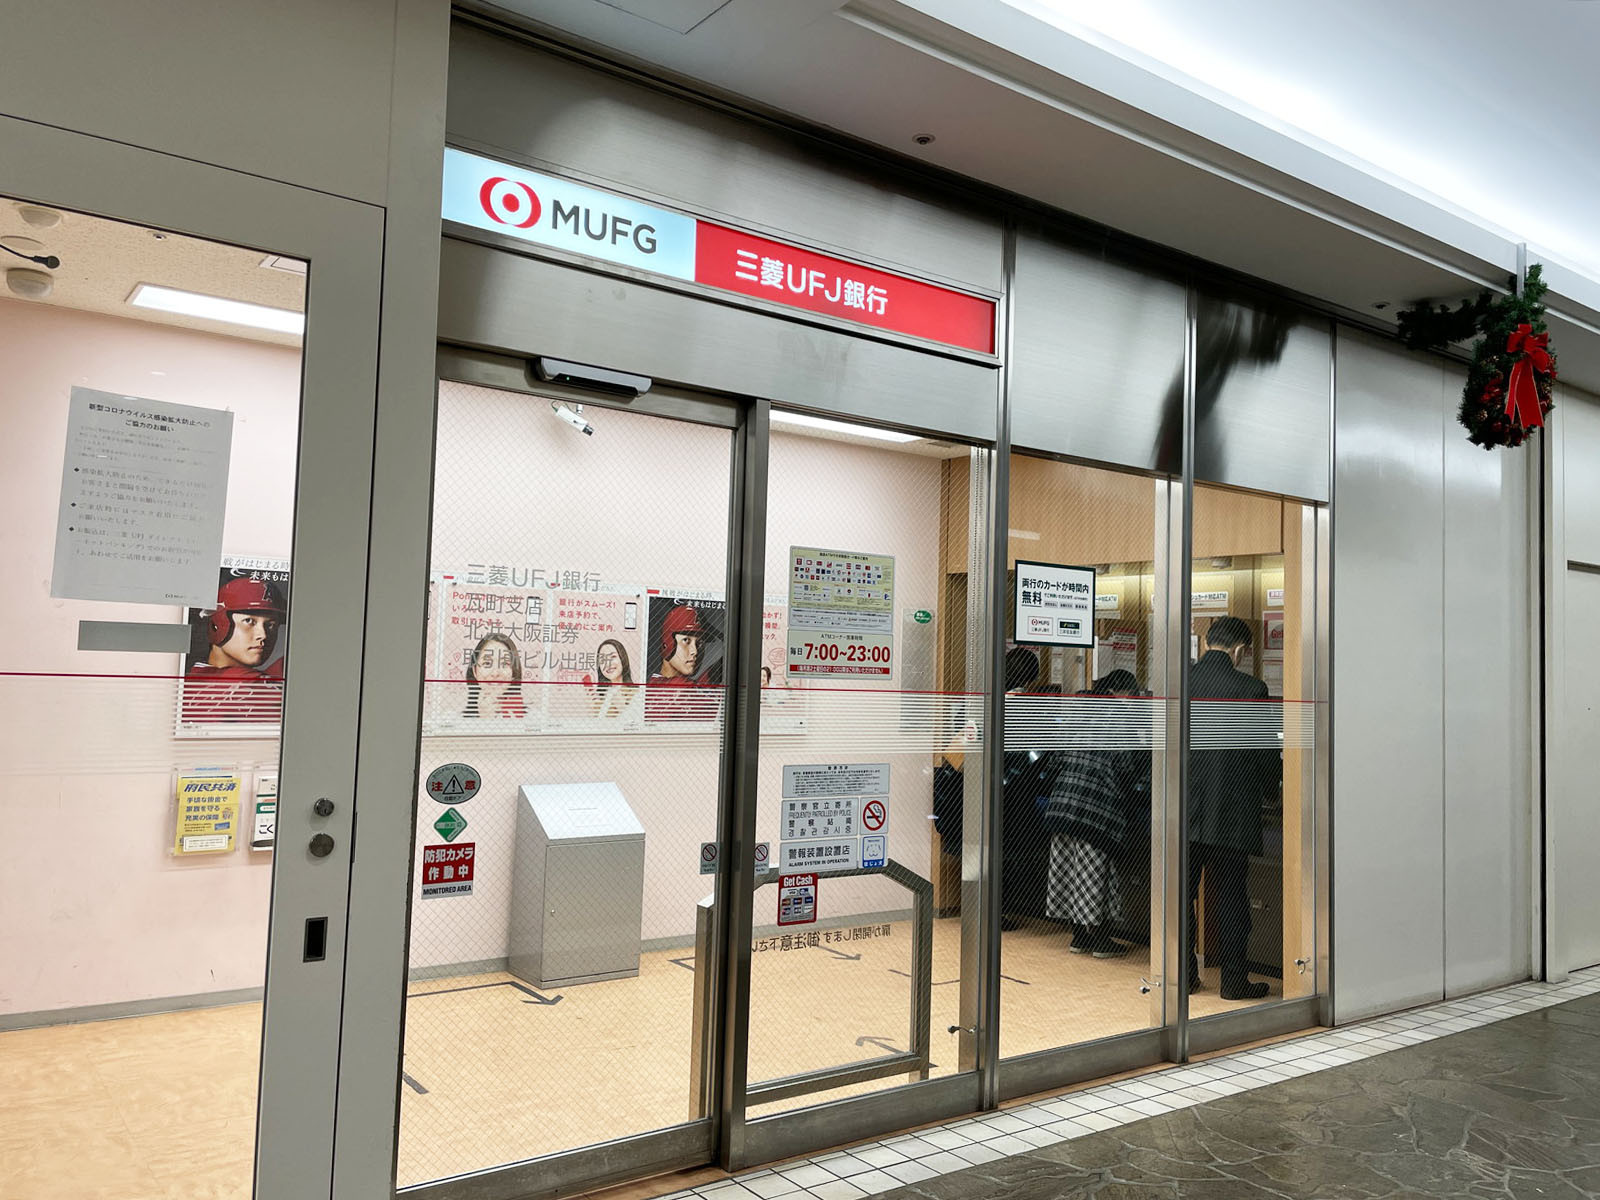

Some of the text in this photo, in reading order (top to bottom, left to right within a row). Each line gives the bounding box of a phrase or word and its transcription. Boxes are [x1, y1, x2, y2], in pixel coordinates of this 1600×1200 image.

[551, 199, 657, 255] MUFG
[735, 248, 889, 316] 三菱UFJ銀行
[88, 402, 211, 428] 新型コロナウイルス感染拡大防止への
[125, 418, 175, 433] ご協力のお願い
[466, 563, 600, 592] 三菱UFJ銀行
[1022, 578, 1089, 594] 両行のカードが時間内
[1022, 590, 1042, 605] 無料
[790, 647, 803, 656] 毎日
[184, 782, 237, 793] 府民共済
[424, 847, 474, 864] 防犯カメラ
[788, 845, 851, 860] 警報装置設置店
[428, 864, 469, 881] 作動中
[783, 875, 814, 887] Get Cash
[422, 884, 472, 896] MONITORED AREA
